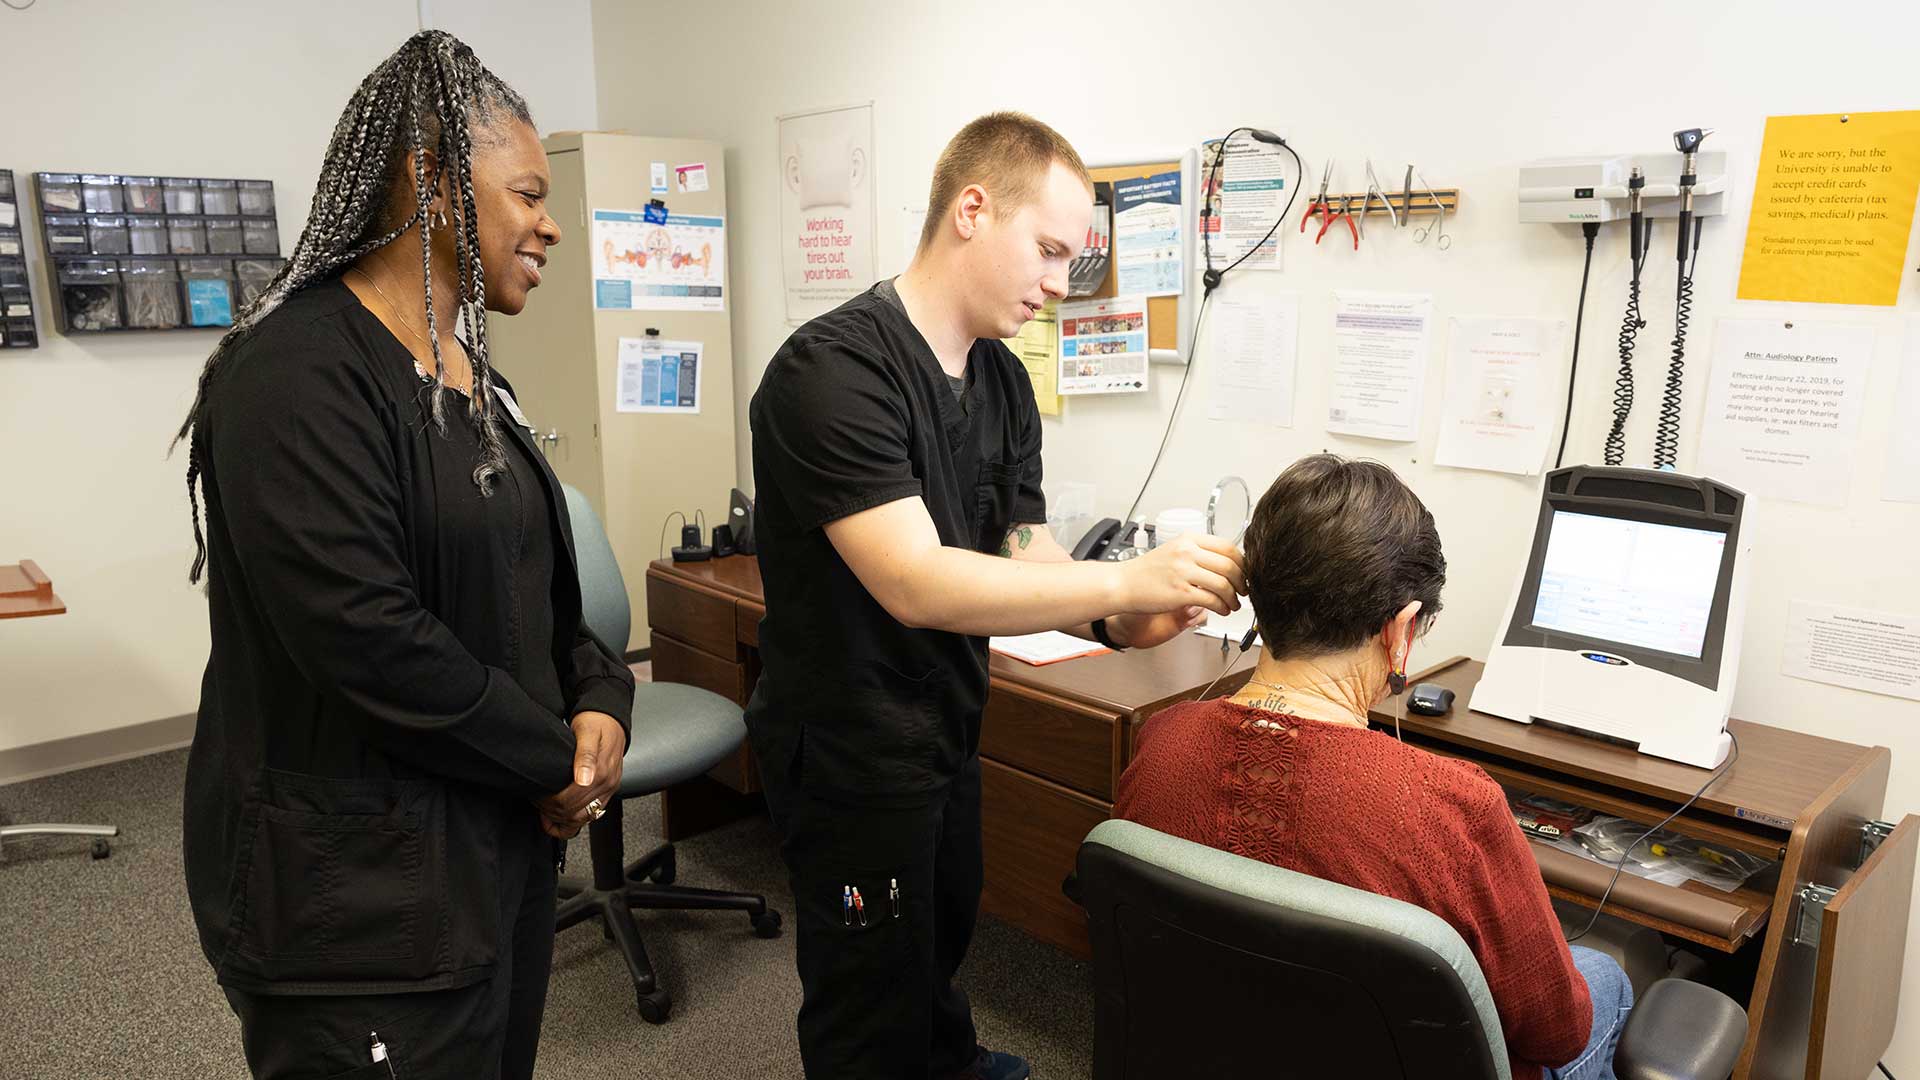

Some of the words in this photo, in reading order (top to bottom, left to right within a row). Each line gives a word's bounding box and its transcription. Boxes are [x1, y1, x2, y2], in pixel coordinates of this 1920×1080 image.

[1779, 149, 1795, 159] We
[1798, 150, 1814, 158] are
[1817, 151, 1846, 161] sorry,
[1849, 148, 1867, 158] but
[1869, 147, 1887, 157] the
[1776, 164, 1828, 175] University
[1831, 164, 1840, 173] is
[1843, 163, 1878, 173] unable
[1881, 164, 1892, 173] to
[1772, 180, 1805, 190] accept
[1807, 179, 1837, 189] credit
[1839, 179, 1867, 188] cards
[1770, 195, 1801, 204] issued
[1803, 195, 1815, 206] by
[1819, 195, 1863, 204] cafeteria
[1866, 195, 1887, 205] (tax
[1767, 209, 1807, 221] savings,
[1810, 209, 1854, 220] medical)
[1857, 209, 1889, 221] plans.
[806, 217, 844, 233] Working
[799, 234, 819, 248] hard
[820, 234, 830, 248] to
[831, 234, 853, 247] hear
[1763, 236, 1796, 245] Standard
[1855, 238, 1875, 246] used
[807, 250, 827, 264] tires
[829, 251, 845, 264] out
[1761, 247, 1771, 255] for
[1772, 248, 1805, 256] cafeteria
[1807, 249, 1823, 257] plan
[803, 267, 824, 283] your
[825, 266, 853, 280] brain.
[1744, 352, 1762, 360] Attn:
[1765, 352, 1803, 362] Audiology
[1805, 355, 1838, 363] Patients
[1732, 371, 1763, 381] Effective
[1764, 373, 1794, 384] January
[1795, 374, 1808, 384] 22,
[1832, 377, 1845, 385] for
[1729, 381, 1757, 392] hearing
[1758, 383, 1773, 392] aids
[1775, 385, 1785, 393] no
[1786, 384, 1811, 396] longer
[1812, 387, 1844, 397] covered
[1731, 392, 1754, 402] under
[1755, 393, 1783, 404] original
[1823, 399, 1838, 408] you
[1727, 404, 1742, 412] may
[1743, 403, 1763, 412] incur
[1770, 405, 1796, 416] charge
[1797, 406, 1809, 415] for
[1810, 407, 1840, 420] hearing
[1725, 412, 1737, 421] aid
[1782, 418, 1798, 426] wax
[1799, 418, 1821, 428] filters
[1822, 420, 1838, 430] and
